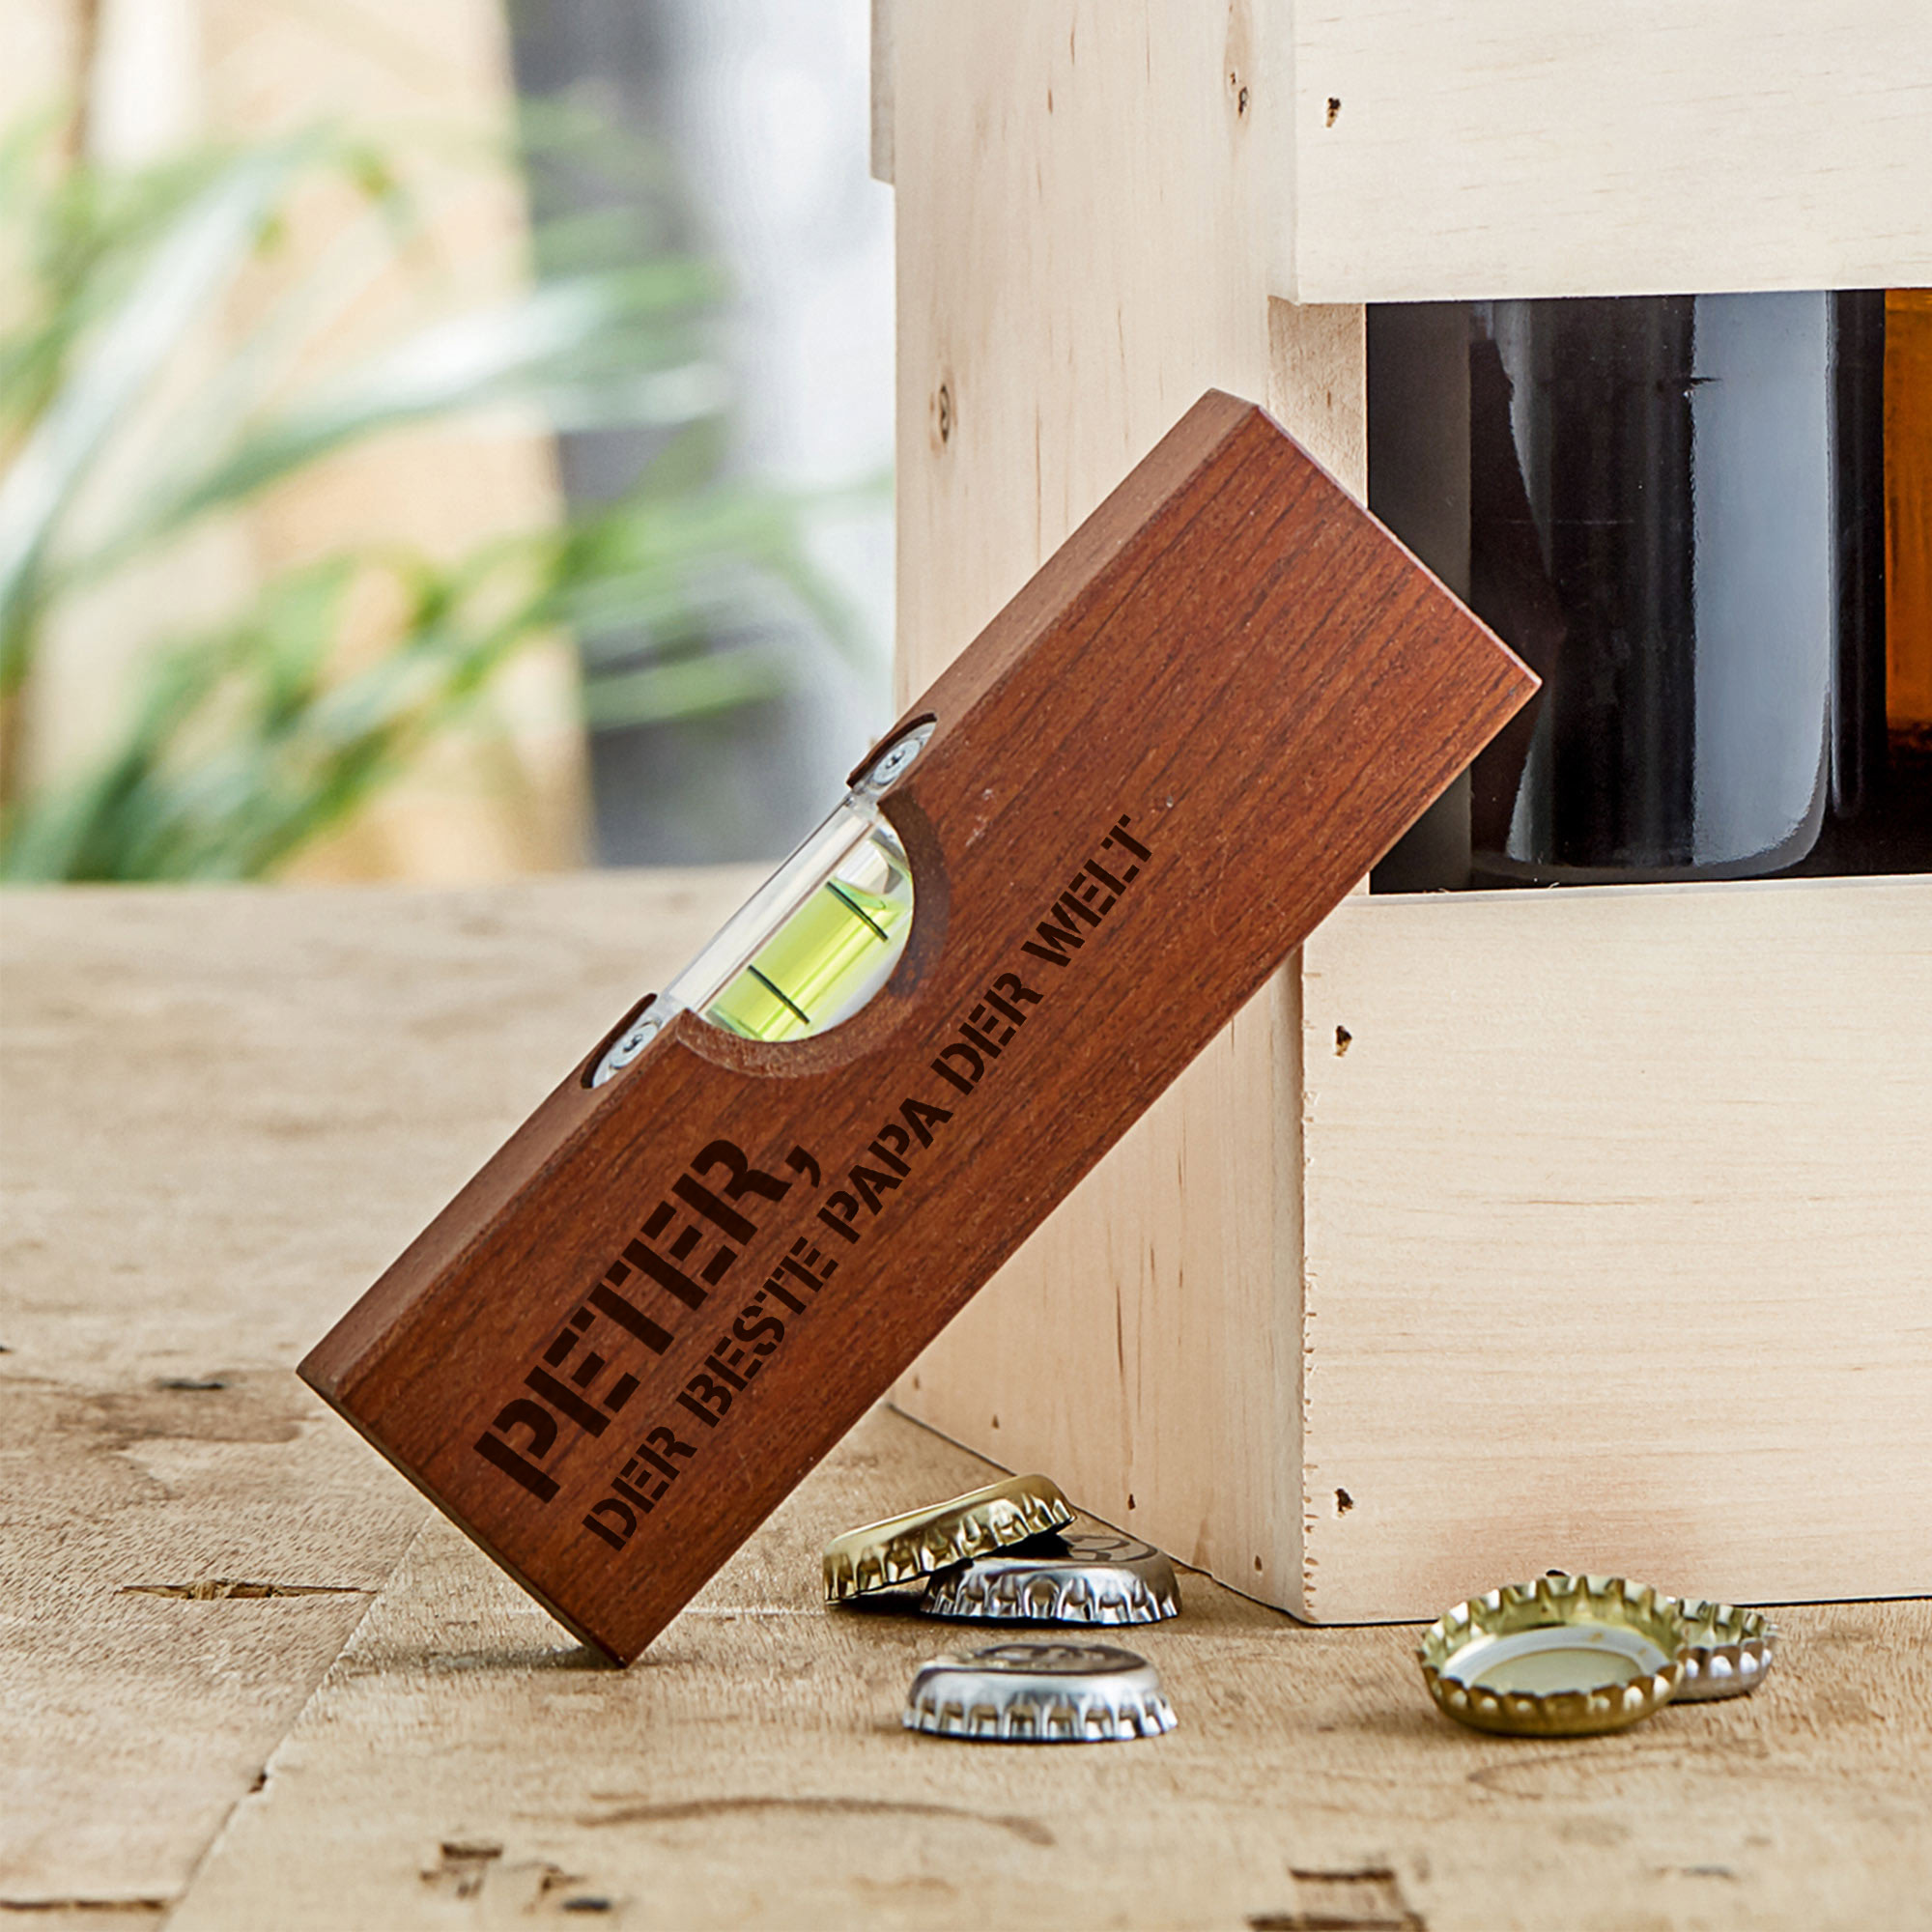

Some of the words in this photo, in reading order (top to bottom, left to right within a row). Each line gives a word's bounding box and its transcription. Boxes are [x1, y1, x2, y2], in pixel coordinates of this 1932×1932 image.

[473, 1139, 823, 1504] PETER,
[581, 1426, 698, 1551] DER
[676, 1236, 838, 1429] BESTE
[816, 1097, 953, 1245] PAPA
[930, 972, 1044, 1096] DER
[1020, 814, 1153, 969] WELT
